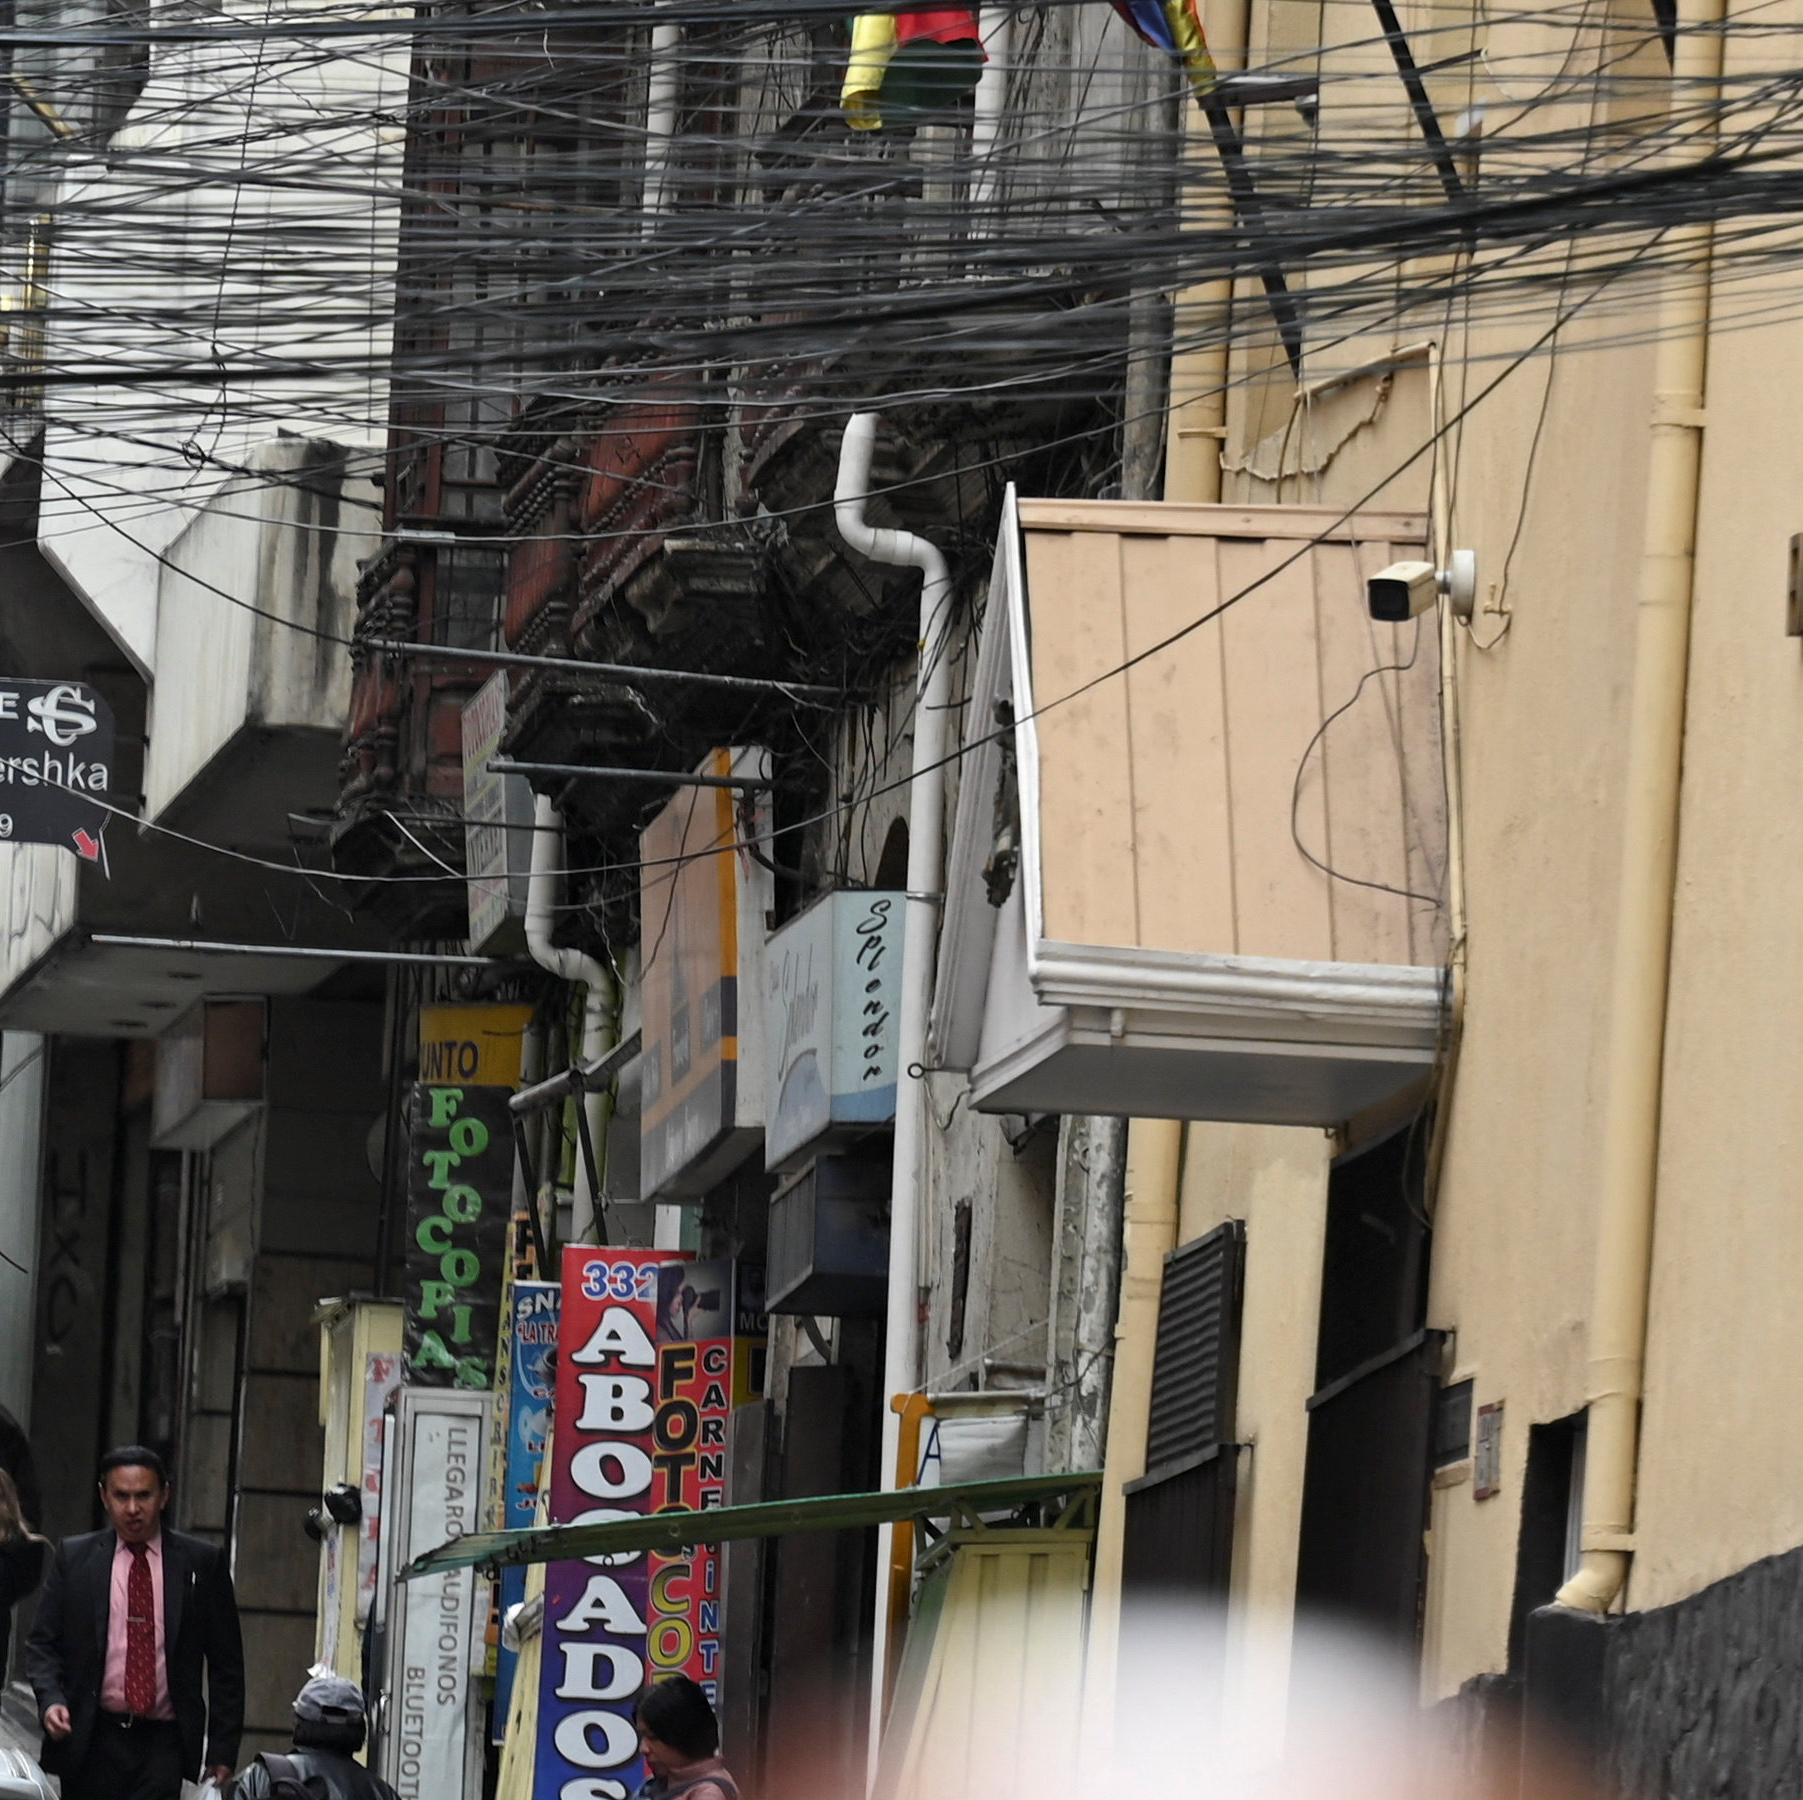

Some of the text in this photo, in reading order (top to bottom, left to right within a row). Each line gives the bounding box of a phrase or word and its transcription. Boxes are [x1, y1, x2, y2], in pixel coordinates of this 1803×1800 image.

[856, 898, 893, 1082] Splendor
[411, 1087, 490, 1390] FOTOCOPIAS
[582, 1259, 658, 1300] 332
[443, 1426, 469, 1534] LLEGARO
